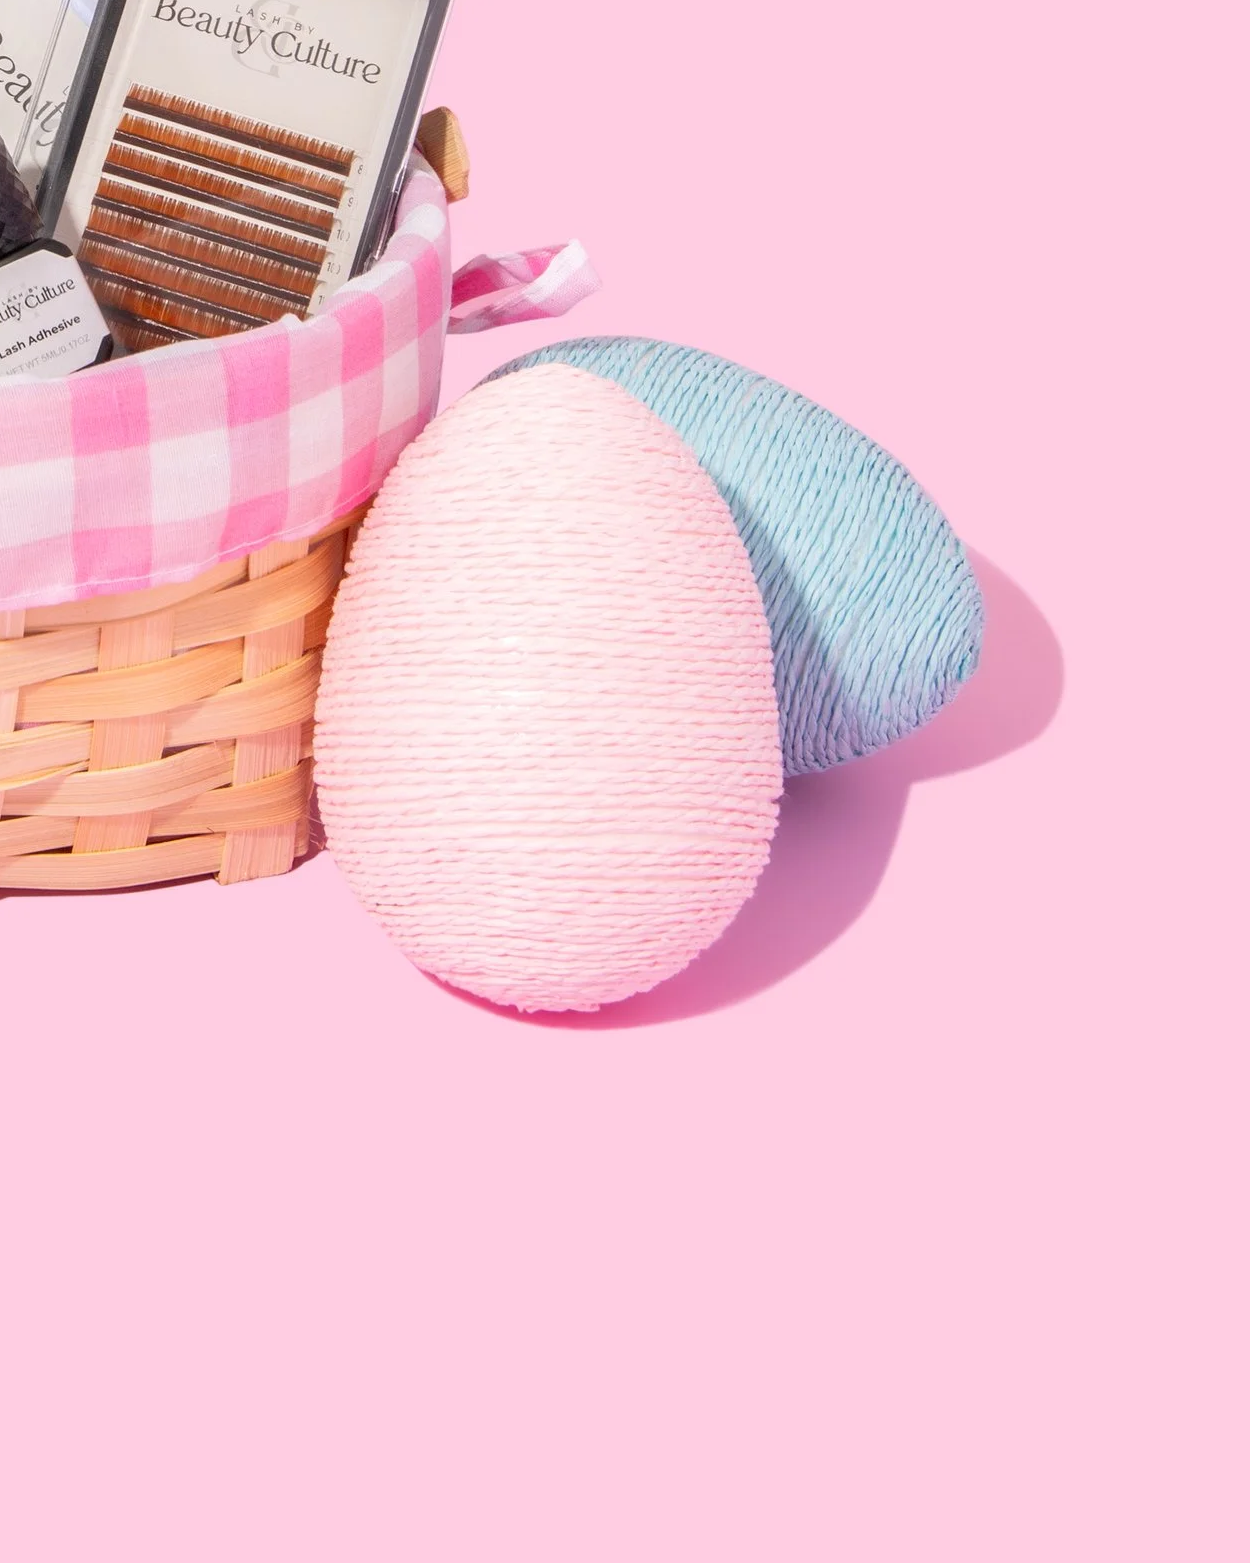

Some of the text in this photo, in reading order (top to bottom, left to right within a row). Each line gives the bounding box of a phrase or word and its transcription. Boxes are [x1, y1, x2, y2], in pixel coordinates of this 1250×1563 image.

[235, 4, 316, 35] LASH BY
[270, 30, 382, 84] Culture
[2, 285, 39, 306] LASH BY
[24, 278, 76, 309] Culture
[28, 315, 81, 347] Adhesive
[25, 357, 41, 370] WT
